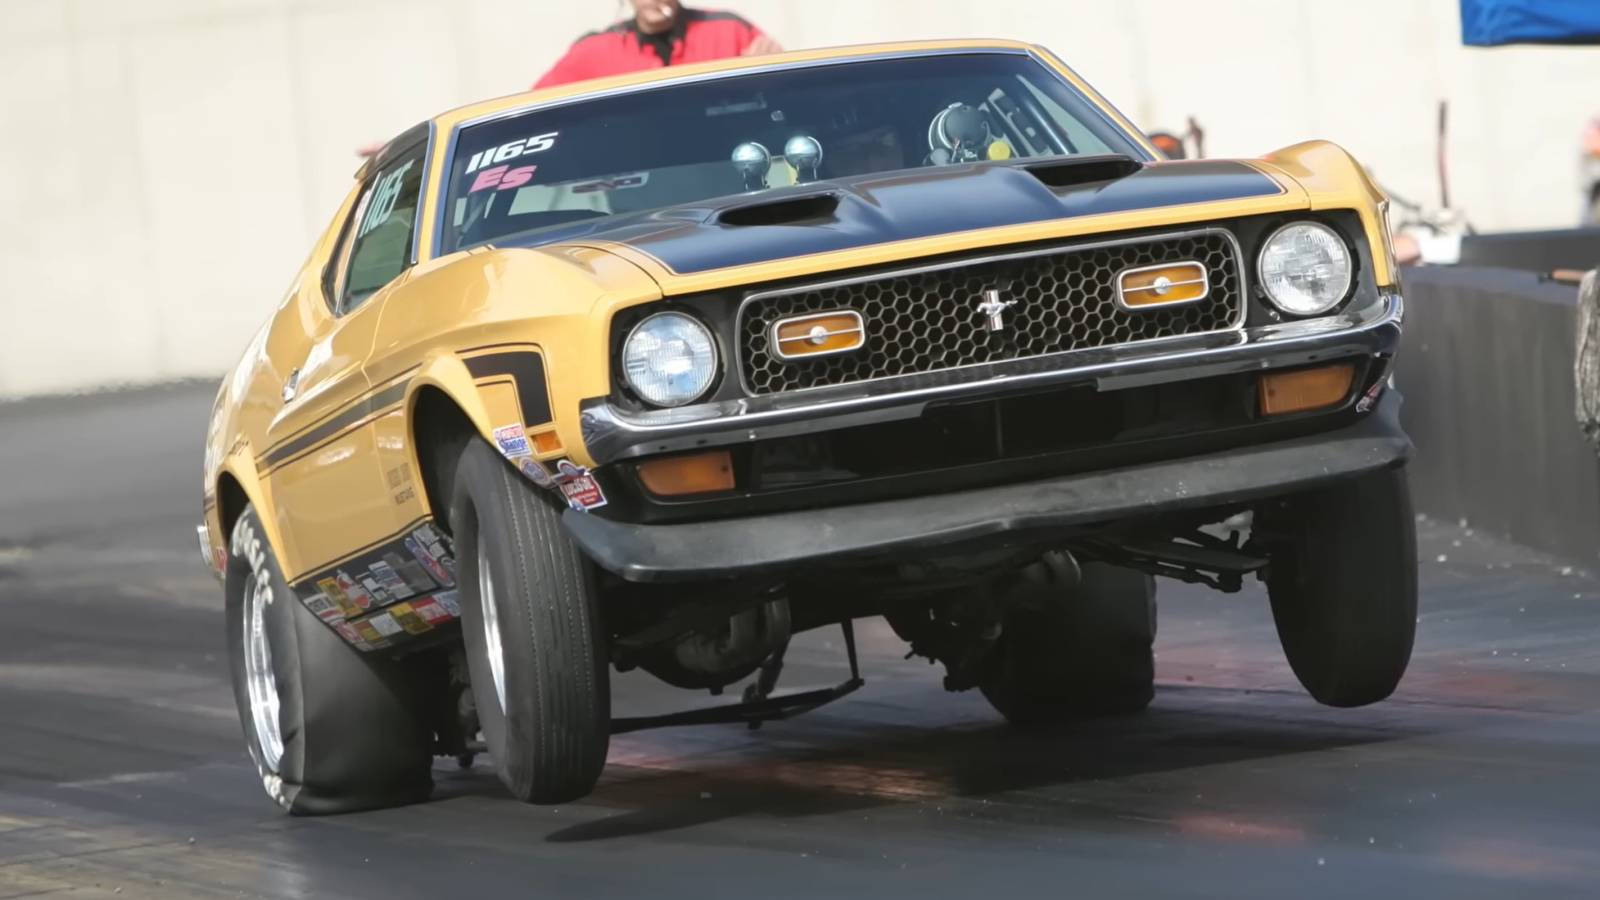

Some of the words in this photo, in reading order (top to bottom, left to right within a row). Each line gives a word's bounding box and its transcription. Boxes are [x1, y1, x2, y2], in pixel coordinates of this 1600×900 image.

[465, 132, 559, 174] 1165
[358, 159, 415, 239] 1165
[469, 165, 538, 193] ES
